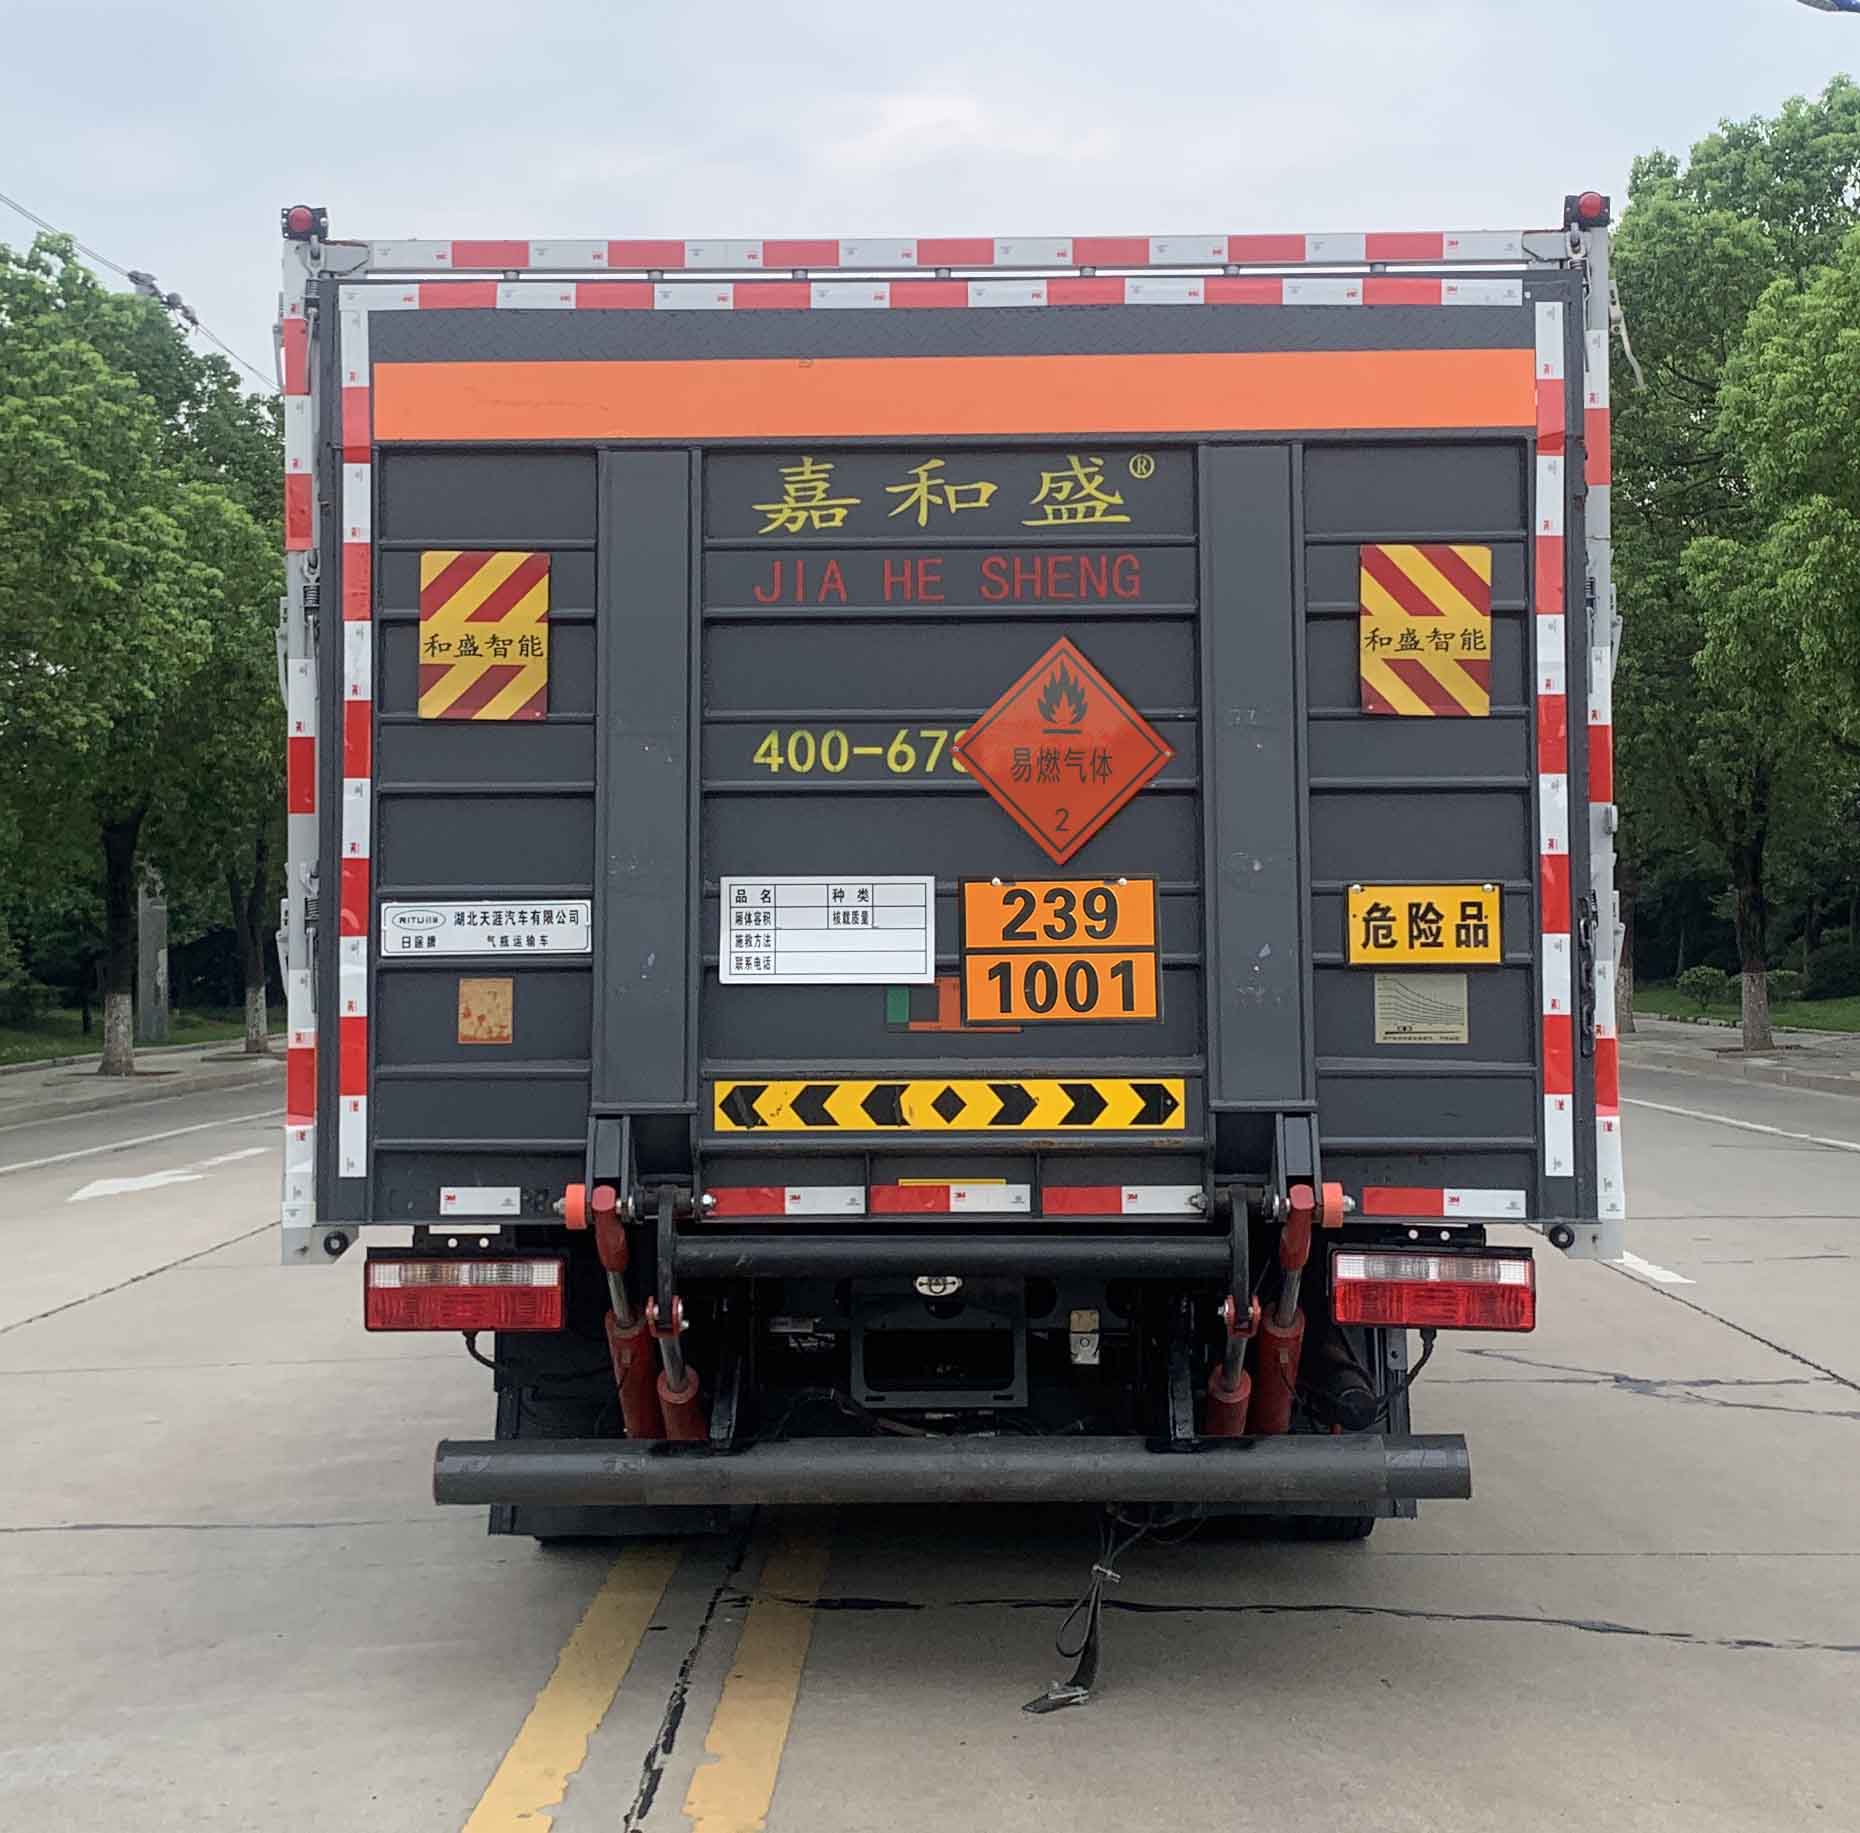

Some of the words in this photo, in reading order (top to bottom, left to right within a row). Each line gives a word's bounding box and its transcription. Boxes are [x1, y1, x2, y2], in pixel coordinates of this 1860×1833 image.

[752, 455, 1131, 533] 嘉和盛
[752, 560, 848, 603] JIA
[884, 558, 944, 601] HE
[980, 554, 1142, 601] SHENG
[424, 633, 544, 658] 和盛智能
[1364, 627, 1487, 652] 和盛智能
[1011, 746, 1113, 785] 易燃气体
[1055, 808, 1070, 832] 2
[735, 889, 772, 904] 品名
[832, 888, 869, 903] 种类
[1002, 887, 1118, 941] 239
[1361, 901, 1489, 949] 危险品
[988, 960, 1134, 1013] 1001
